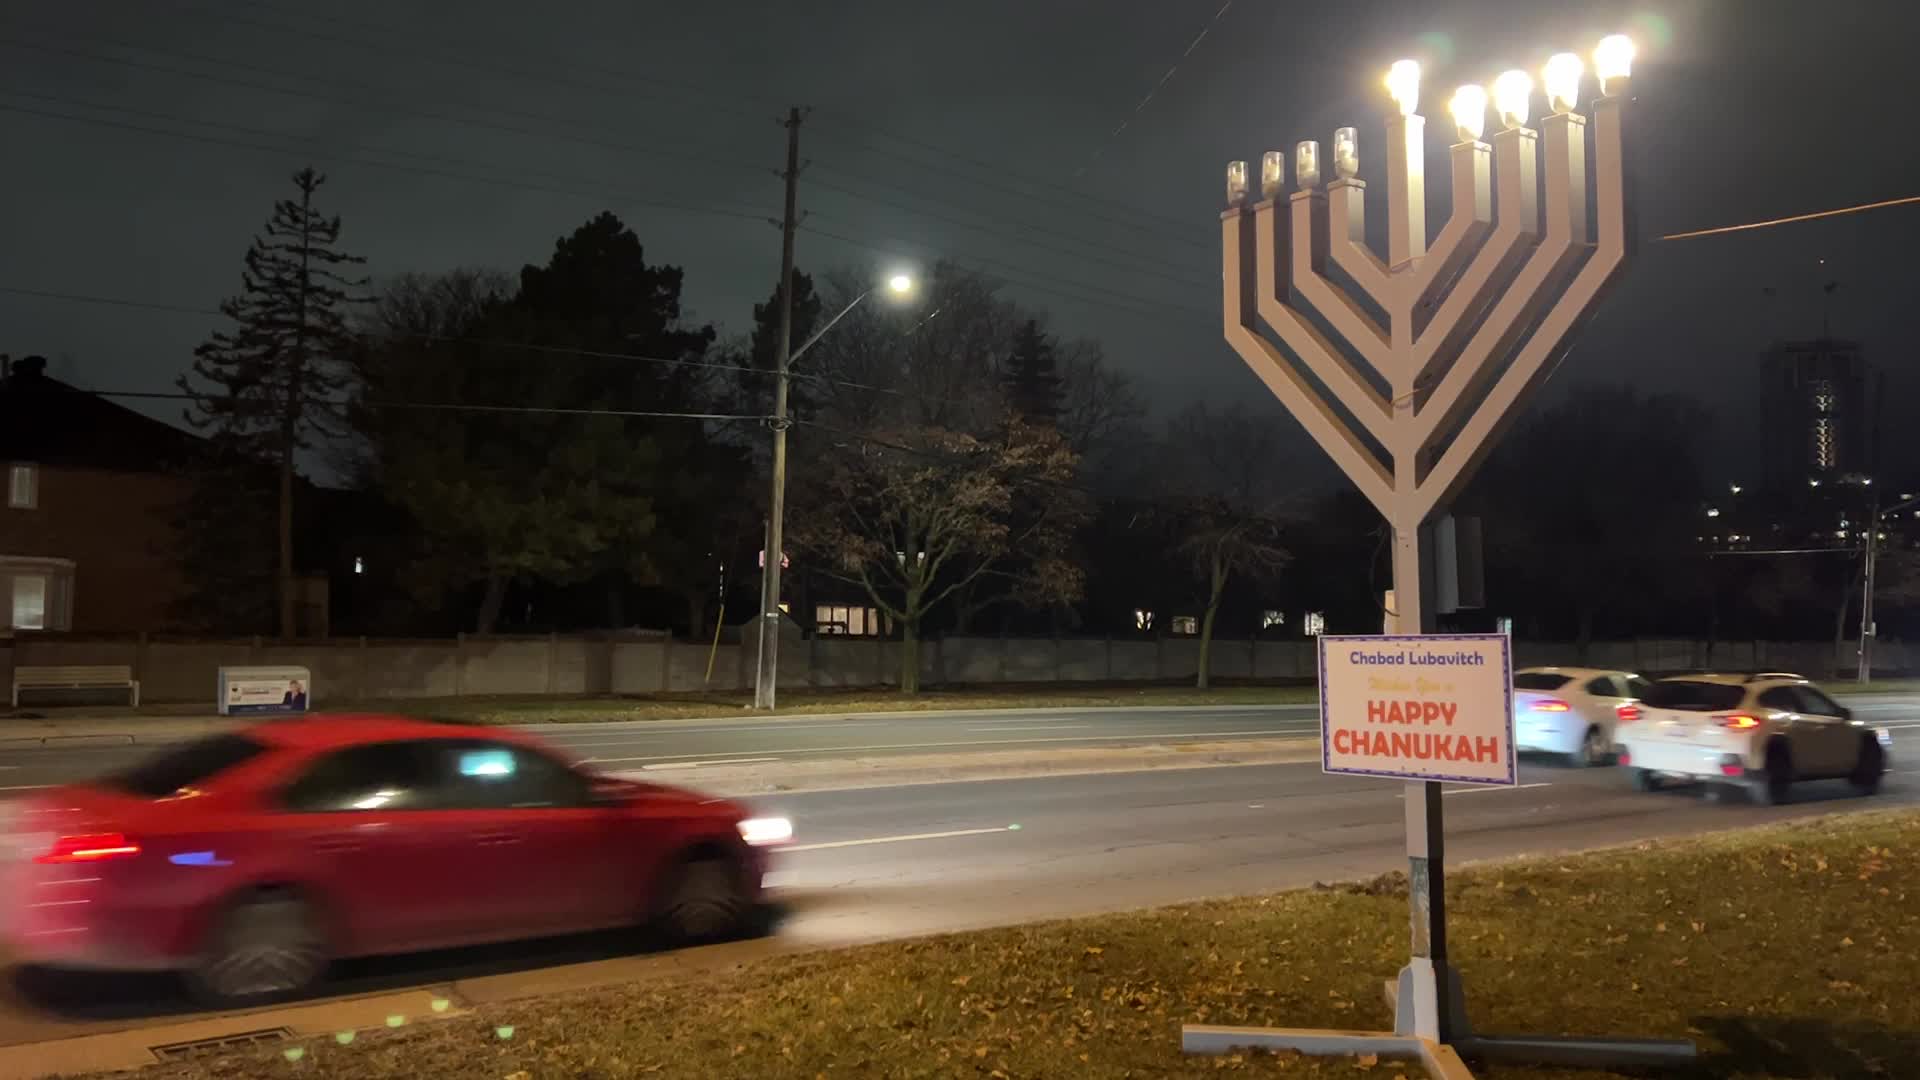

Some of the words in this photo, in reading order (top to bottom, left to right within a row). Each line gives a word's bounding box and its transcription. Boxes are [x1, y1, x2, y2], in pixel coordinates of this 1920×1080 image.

[1350, 651, 1405, 665] Chabad
[1409, 651, 1484, 666] Lubavitch
[1367, 700, 1457, 725] HAPPY
[1333, 729, 1499, 763] CHANUKAH
